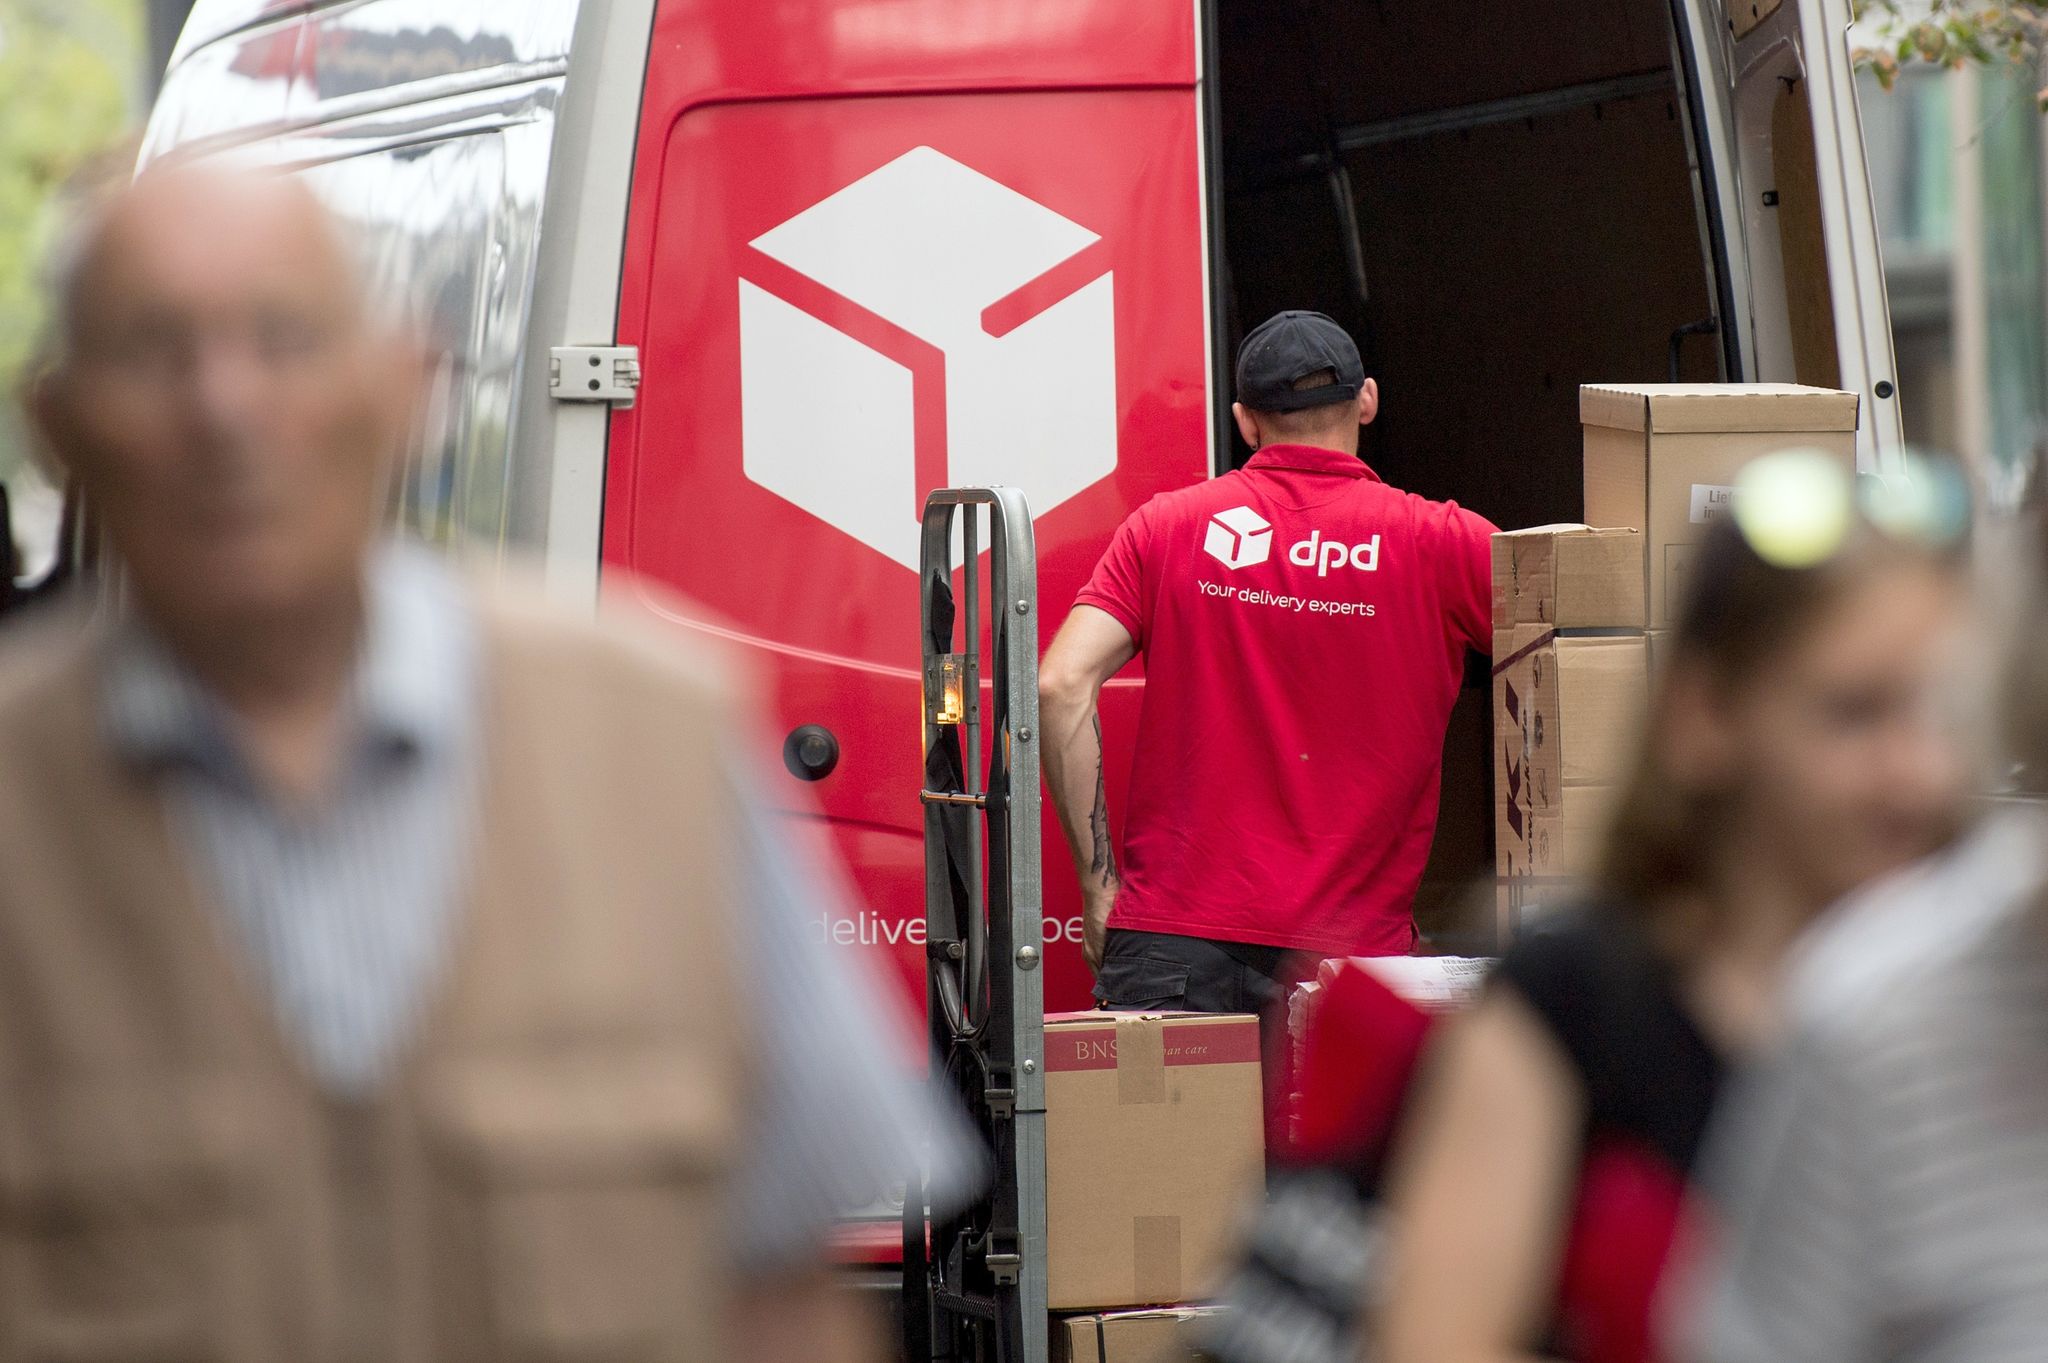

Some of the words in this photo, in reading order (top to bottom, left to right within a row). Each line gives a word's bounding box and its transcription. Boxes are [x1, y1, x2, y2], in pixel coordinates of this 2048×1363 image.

[1289, 530, 1381, 577] dpd
[1198, 579, 1237, 598] Your
[1238, 587, 1306, 612] delivery
[1308, 599, 1375, 616] experts
[1505, 678, 1523, 920] EKI
[807, 911, 927, 945] delive
[1185, 1046, 1208, 1055] care
